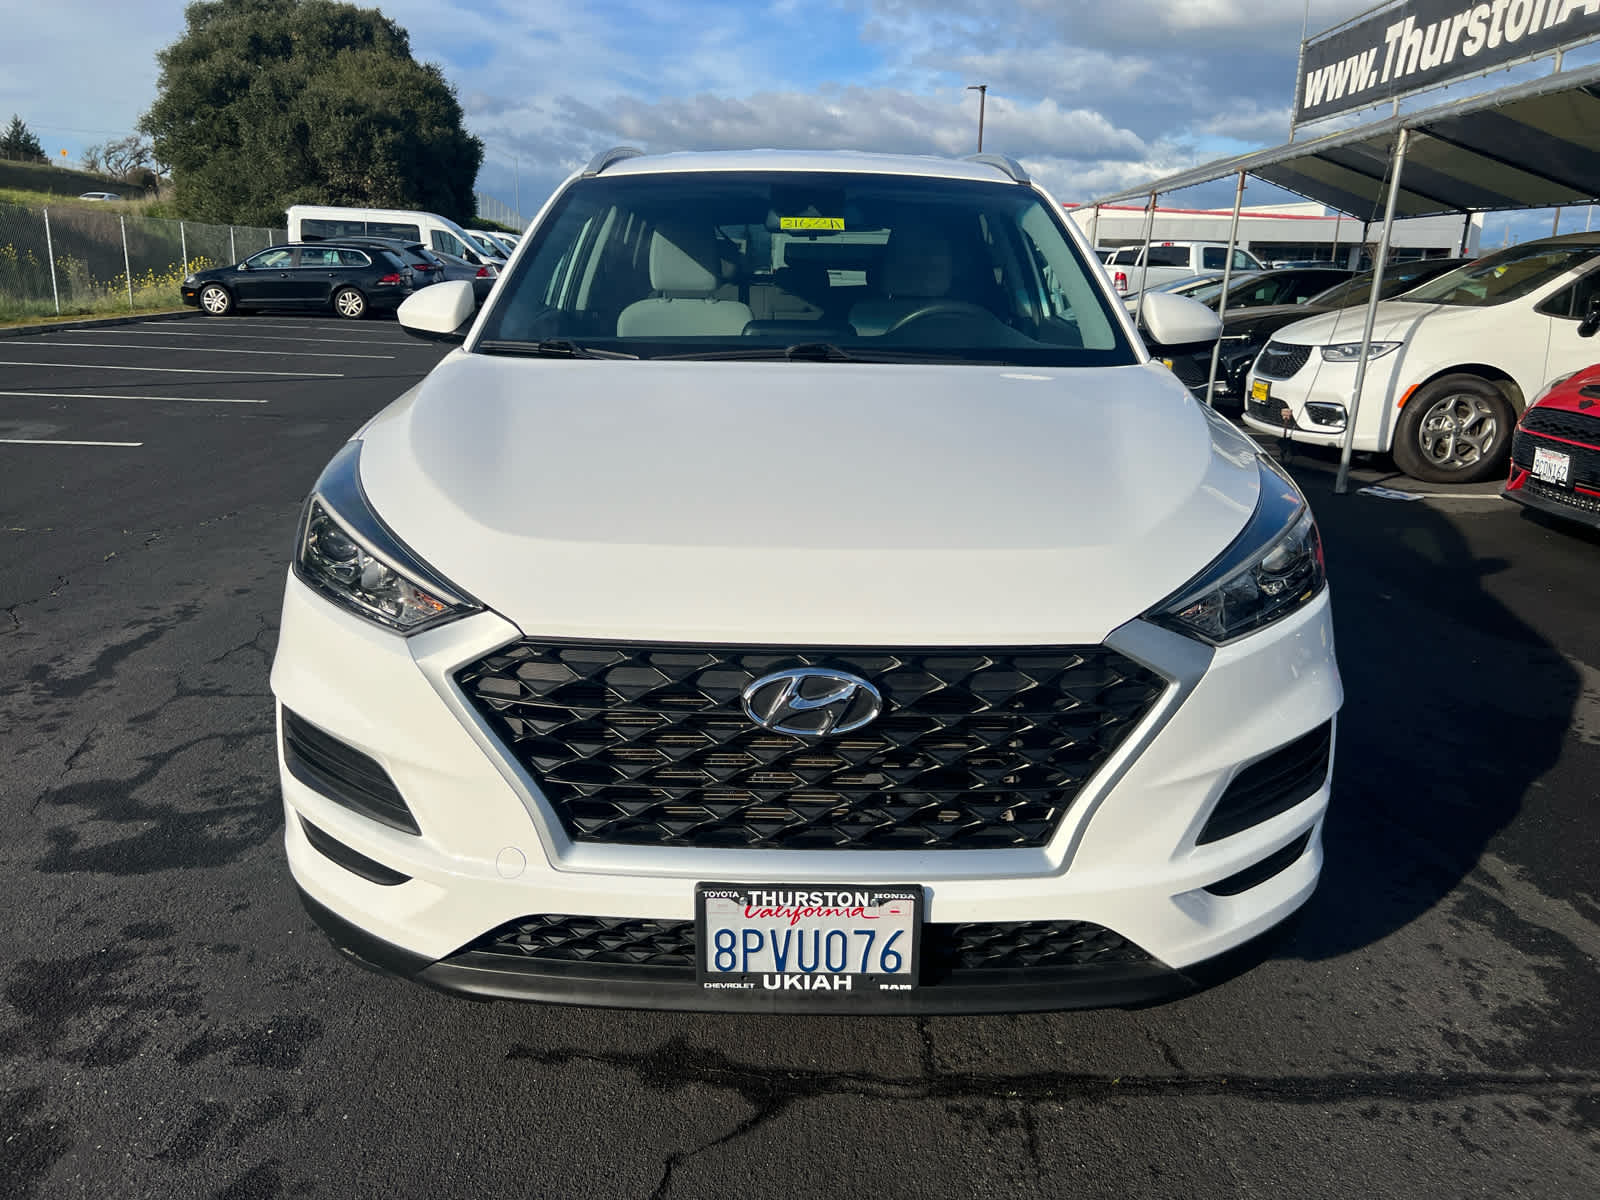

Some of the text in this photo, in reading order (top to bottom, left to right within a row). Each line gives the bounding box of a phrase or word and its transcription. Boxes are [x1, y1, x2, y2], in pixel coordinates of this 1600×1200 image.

[703, 890, 740, 898] TOYOTA
[747, 890, 869, 907] THURSTON
[744, 904, 880, 926] California
[714, 928, 905, 974] 8PVU076
[763, 974, 852, 991] UKIAH
